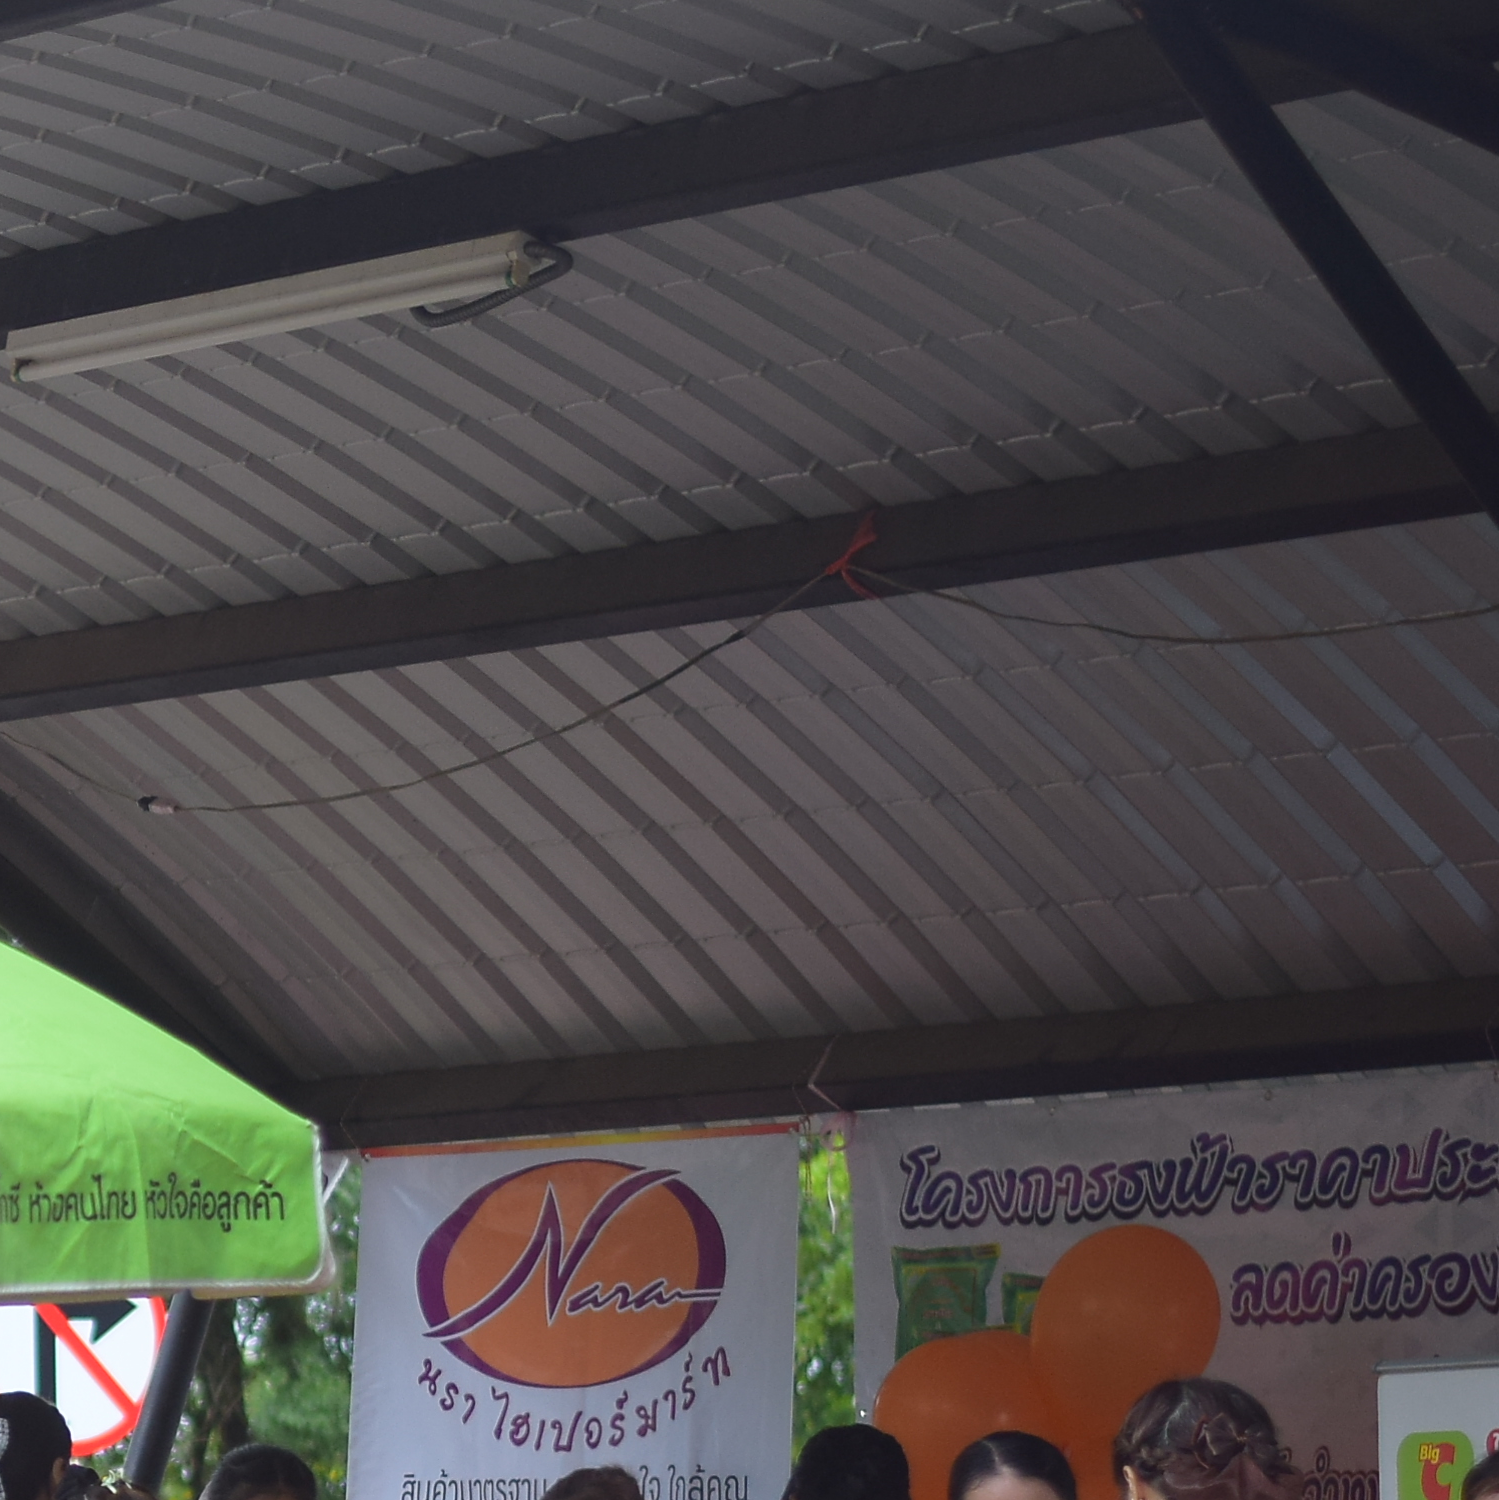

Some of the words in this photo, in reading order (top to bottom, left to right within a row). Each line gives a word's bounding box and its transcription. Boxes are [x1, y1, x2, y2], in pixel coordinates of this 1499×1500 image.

[30, 1173, 136, 1222] ห้างคนไทย
[144, 1171, 285, 1232] หัวใจคือลูกค้า
[422, 1168, 721, 1328] Nara
[418, 1357, 477, 1425] นรา
[1420, 1443, 1440, 1463] Big
